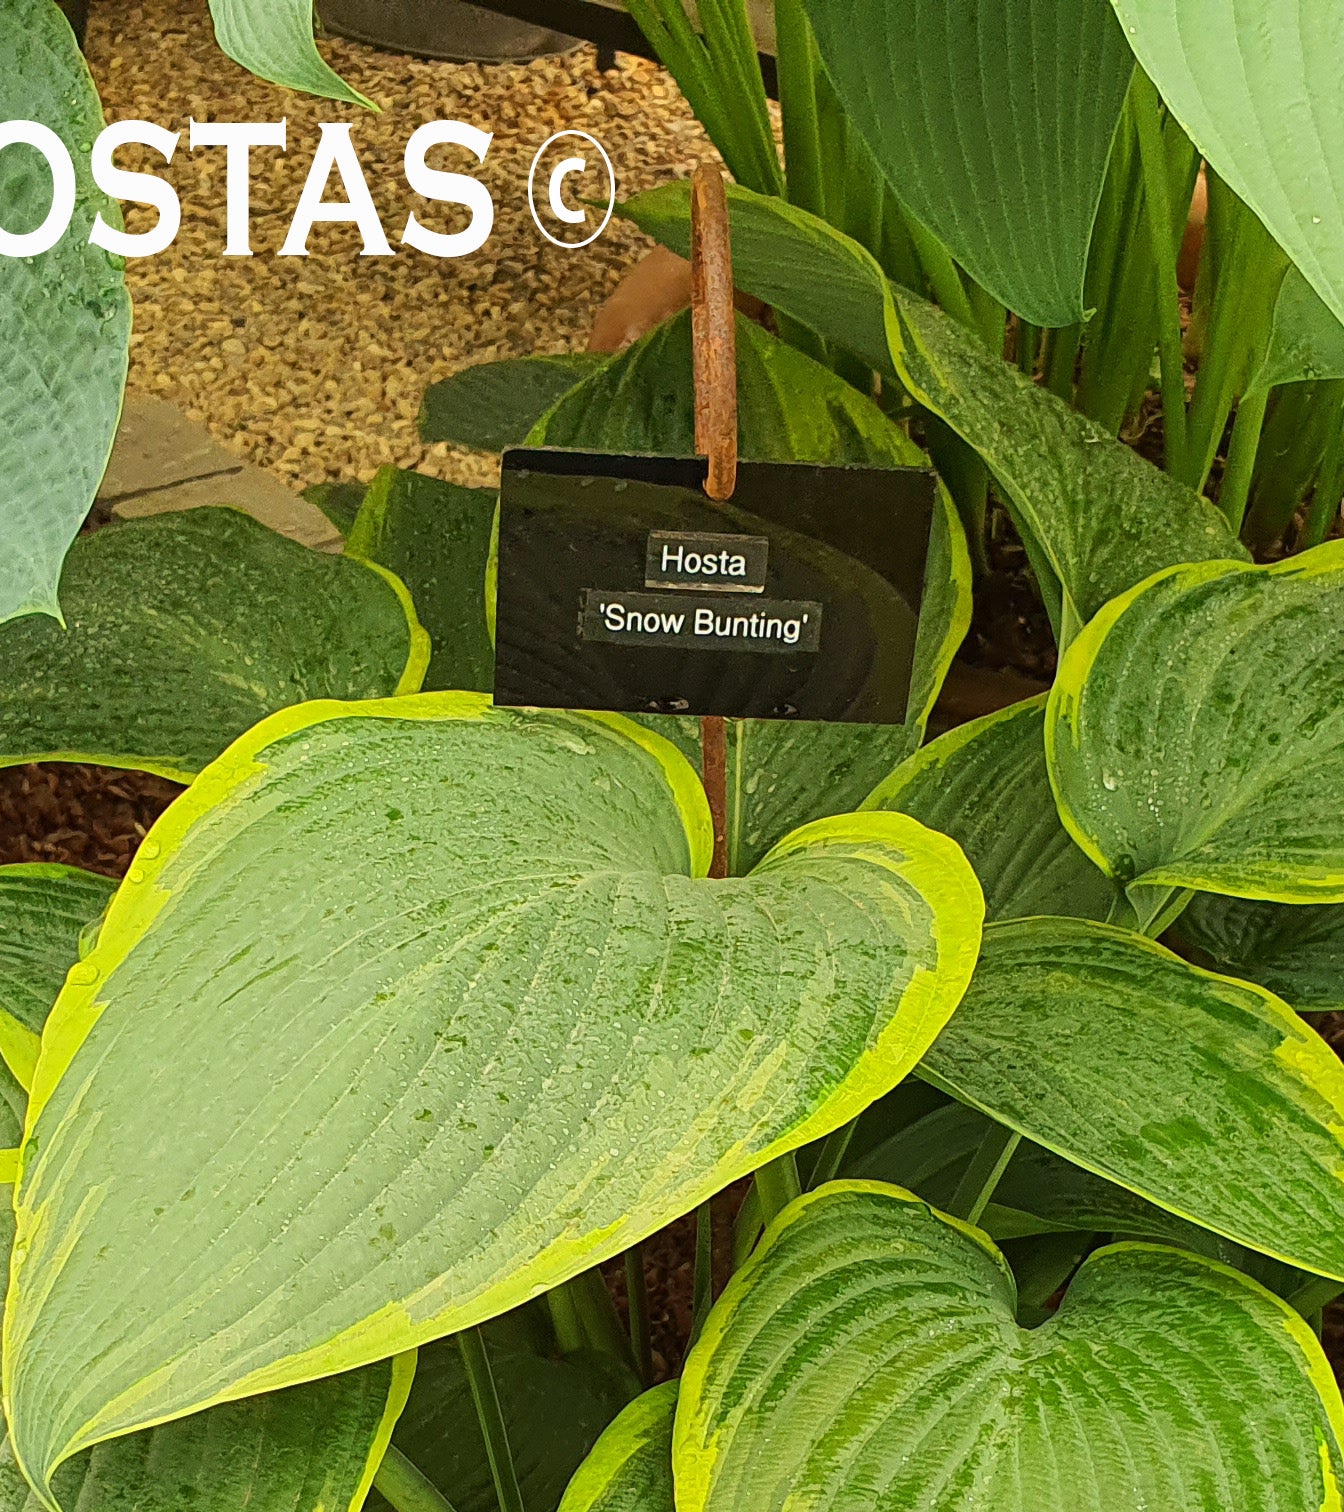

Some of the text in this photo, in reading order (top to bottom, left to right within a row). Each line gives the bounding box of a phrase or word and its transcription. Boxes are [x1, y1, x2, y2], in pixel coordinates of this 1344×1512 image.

[661, 545, 746, 576] Hosta
[599, 603, 809, 643] 'Snow Bunting'
